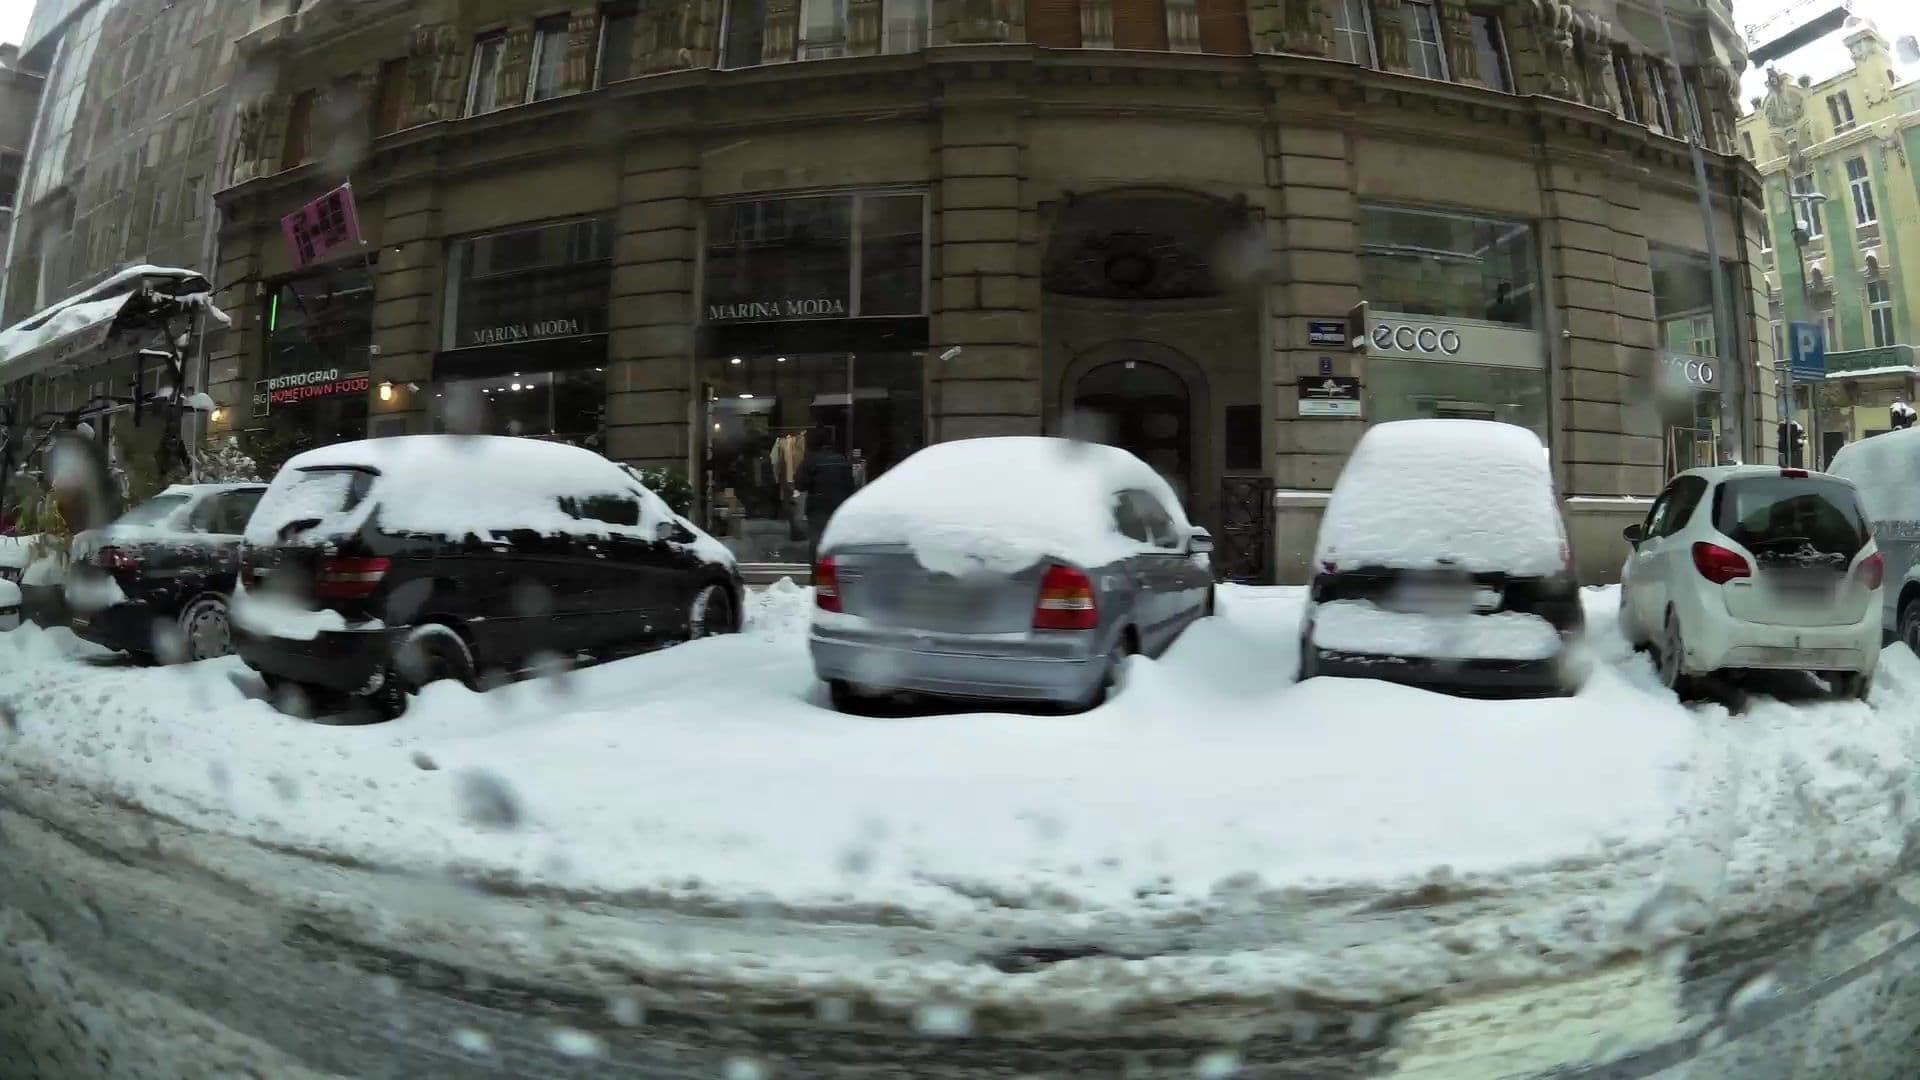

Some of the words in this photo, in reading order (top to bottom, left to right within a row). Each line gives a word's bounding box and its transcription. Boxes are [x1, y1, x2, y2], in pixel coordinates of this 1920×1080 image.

[708, 301, 781, 320] MARINA
[785, 298, 844, 316] MODA
[473, 323, 529, 344] MARINA
[533, 318, 579, 336] MODA
[1371, 323, 1460, 355] ecco
[270, 383, 332, 402] HOMETOWN
[335, 379, 369, 393] FOOD
